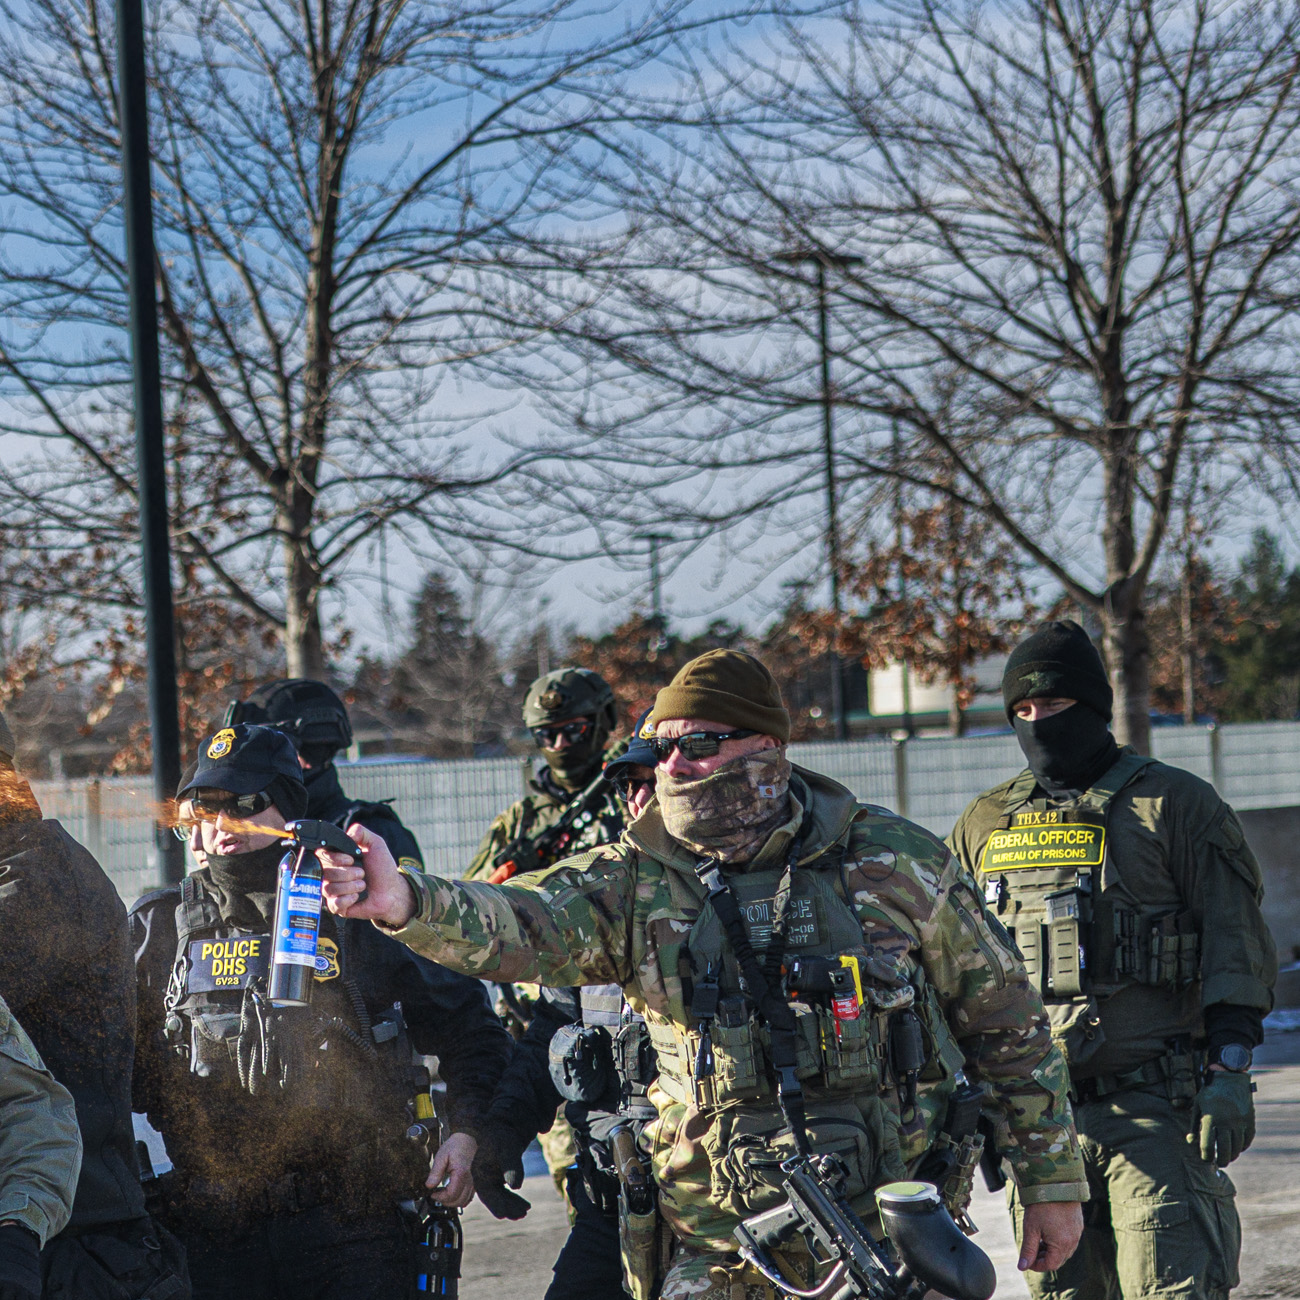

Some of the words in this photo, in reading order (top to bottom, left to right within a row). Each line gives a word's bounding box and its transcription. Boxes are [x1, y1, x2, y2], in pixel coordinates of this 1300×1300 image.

[1016, 811, 1058, 826] THX-12
[989, 831, 1038, 851] FEDERAL
[1038, 829, 1095, 846] OFFICER
[992, 849, 1026, 864] BUREAU
[1027, 850, 1042, 860] OF
[1042, 848, 1087, 860] PRISONS
[738, 899, 813, 923] OLCE
[201, 939, 261, 961] POLICE
[211, 957, 248, 977] DHS
